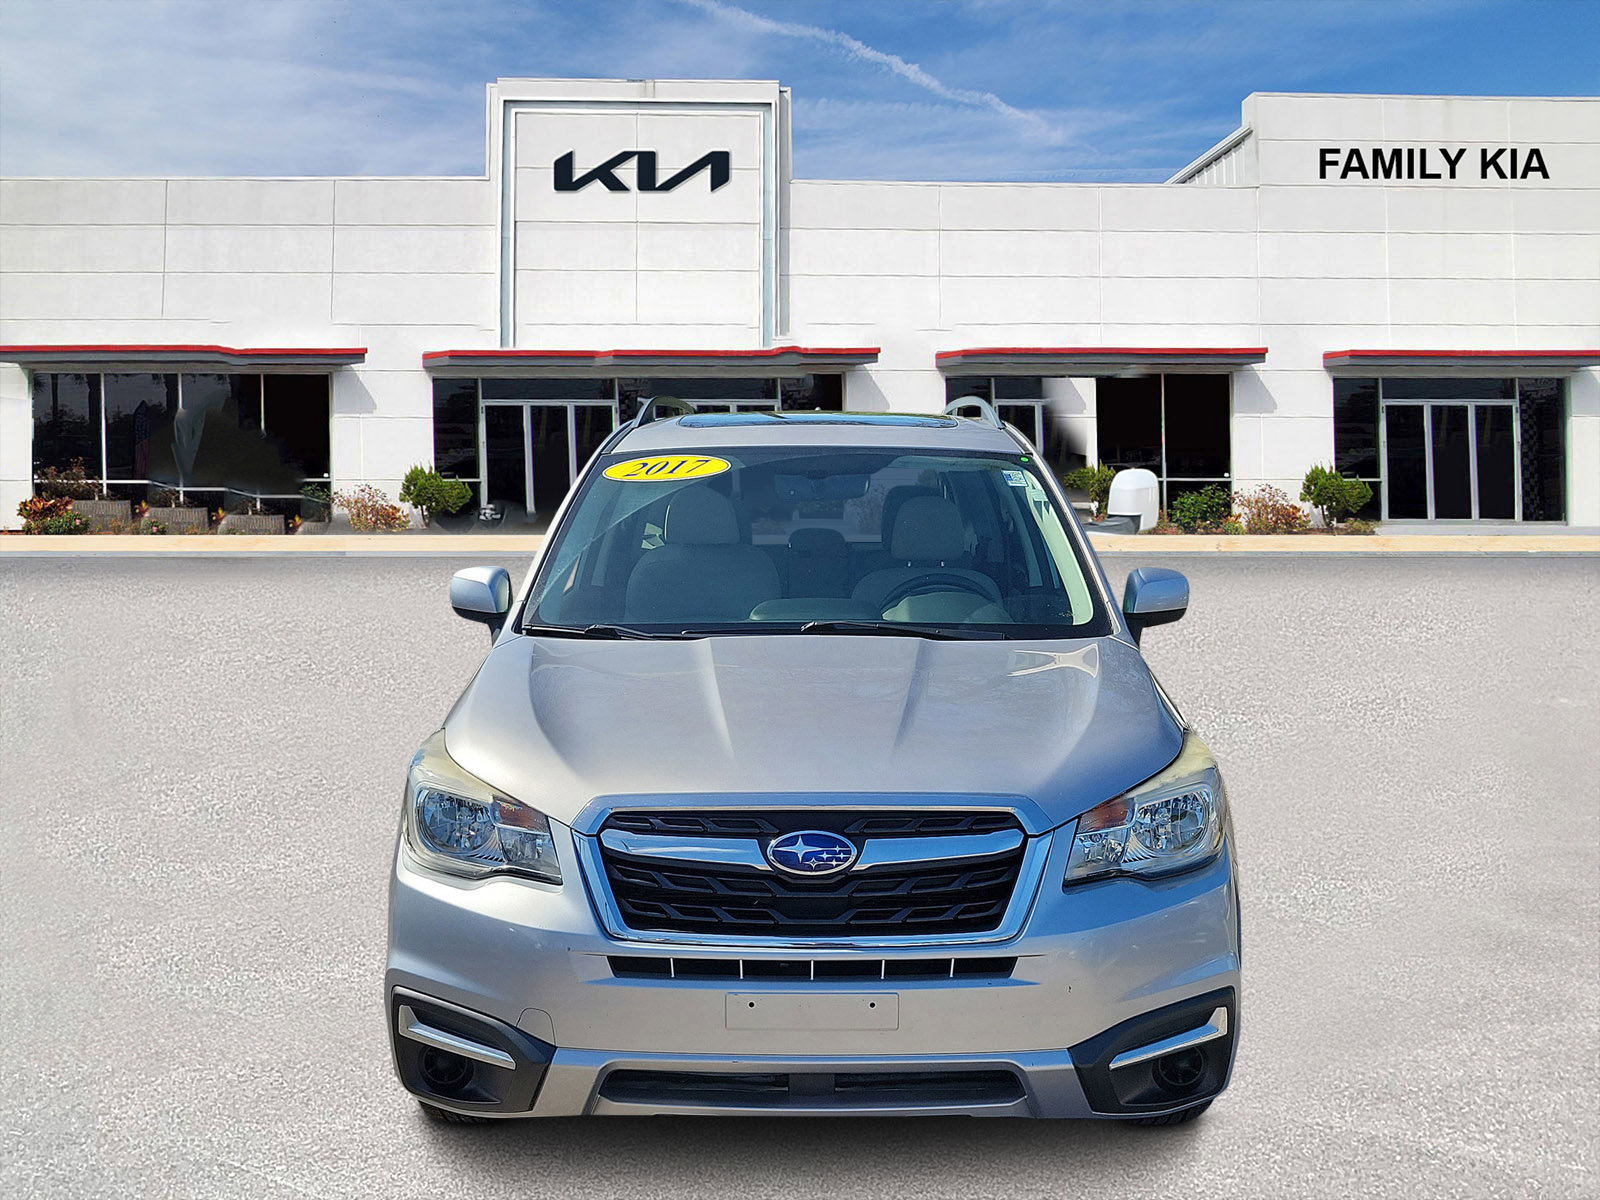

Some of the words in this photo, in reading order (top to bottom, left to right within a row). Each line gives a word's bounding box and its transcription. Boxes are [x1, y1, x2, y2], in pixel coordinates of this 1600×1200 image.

[554, 150, 730, 192] KIA
[1319, 148, 1467, 180] FAMILY
[1480, 148, 1550, 180] KIA
[622, 459, 712, 477] 2017
